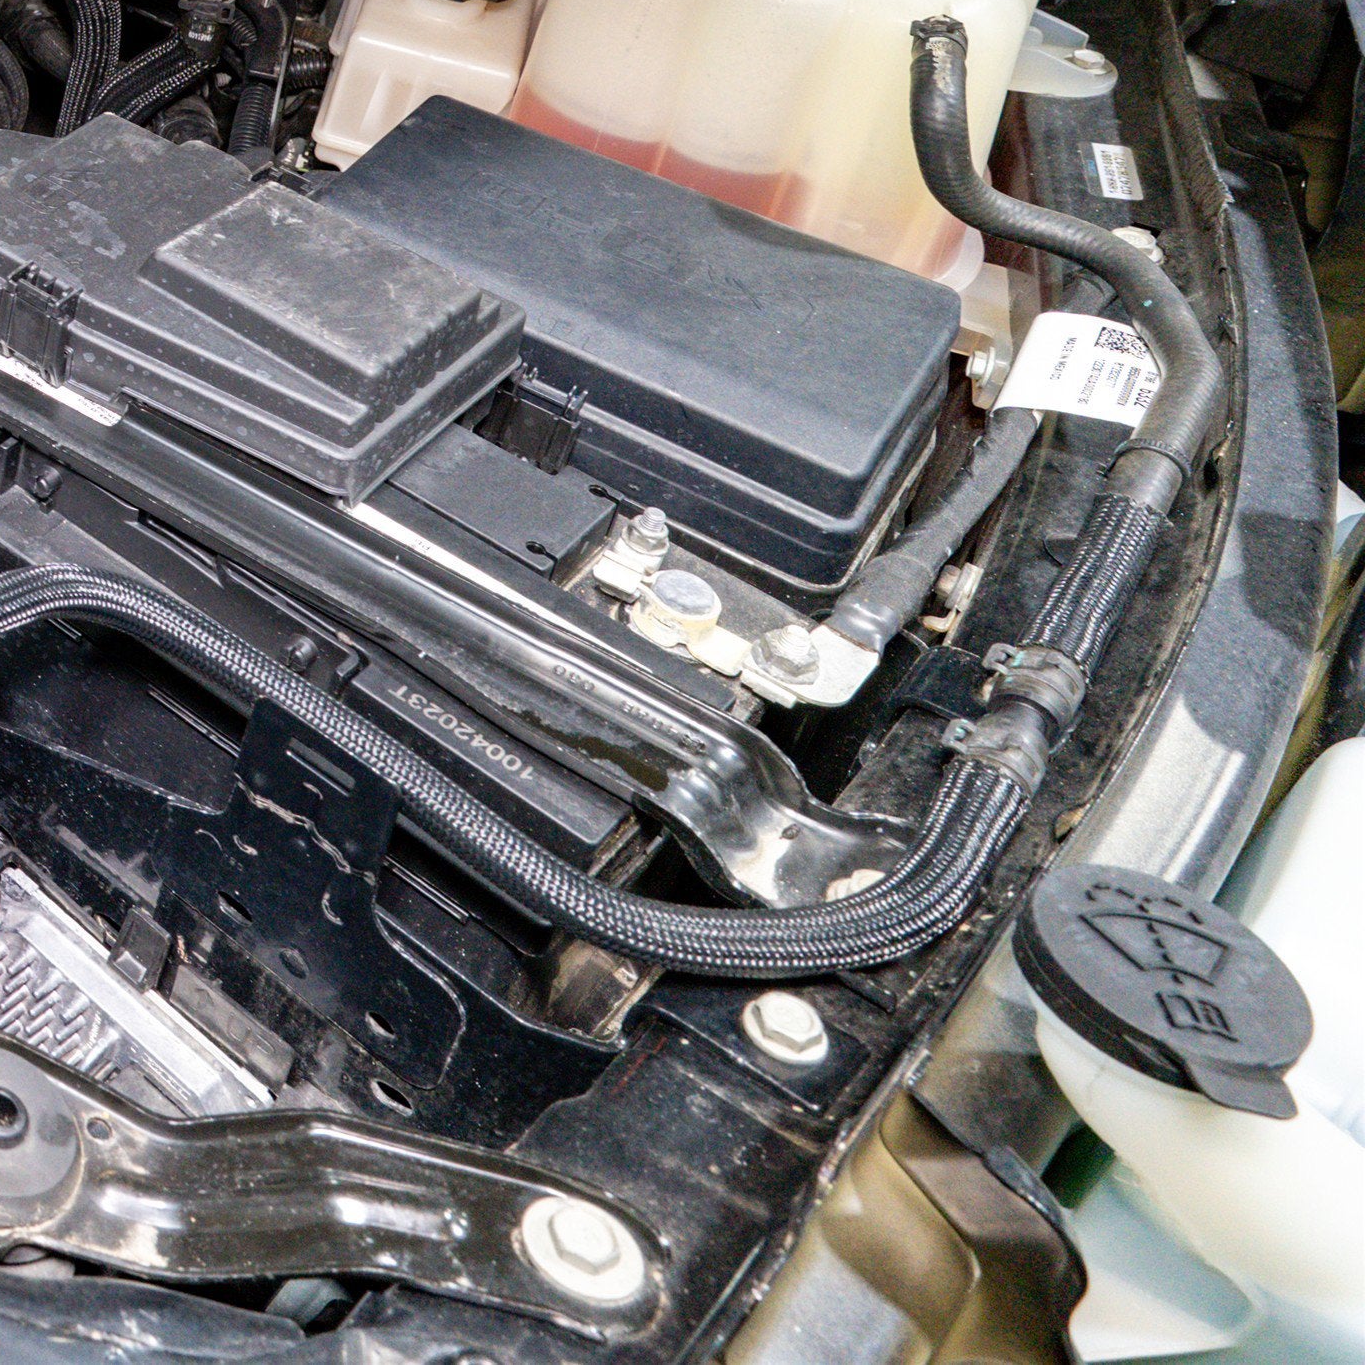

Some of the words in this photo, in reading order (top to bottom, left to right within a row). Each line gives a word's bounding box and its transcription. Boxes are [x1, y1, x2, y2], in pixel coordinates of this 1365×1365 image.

[1062, 338, 1077, 352] MADE
[1050, 361, 1068, 380] MEXICO
[387, 685, 535, 781] 10042023T
